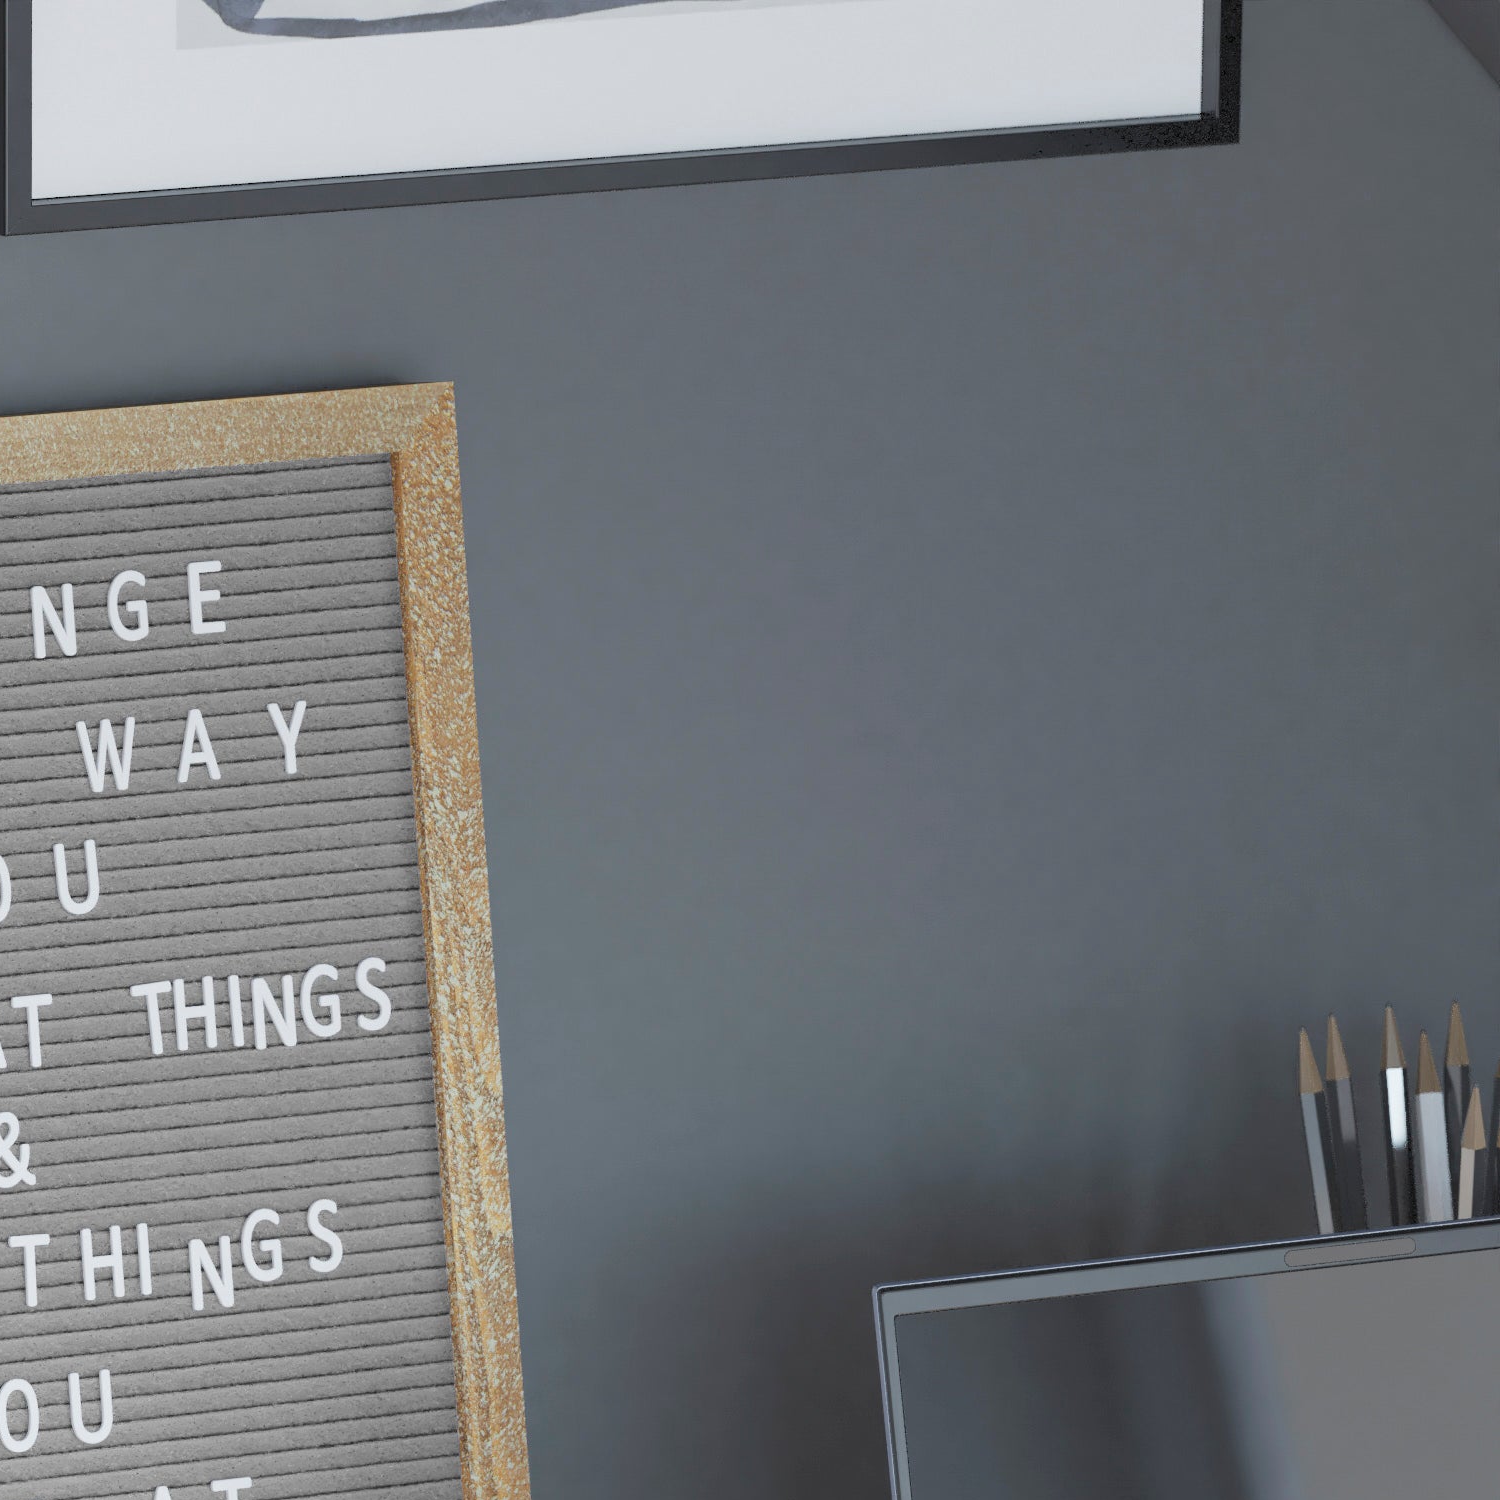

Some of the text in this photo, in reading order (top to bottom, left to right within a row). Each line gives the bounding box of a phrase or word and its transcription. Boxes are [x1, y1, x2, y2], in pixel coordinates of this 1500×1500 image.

[75, 699, 309, 795] WAY
[129, 955, 394, 1057] THINGS
[7, 1197, 345, 1313] THINGS
